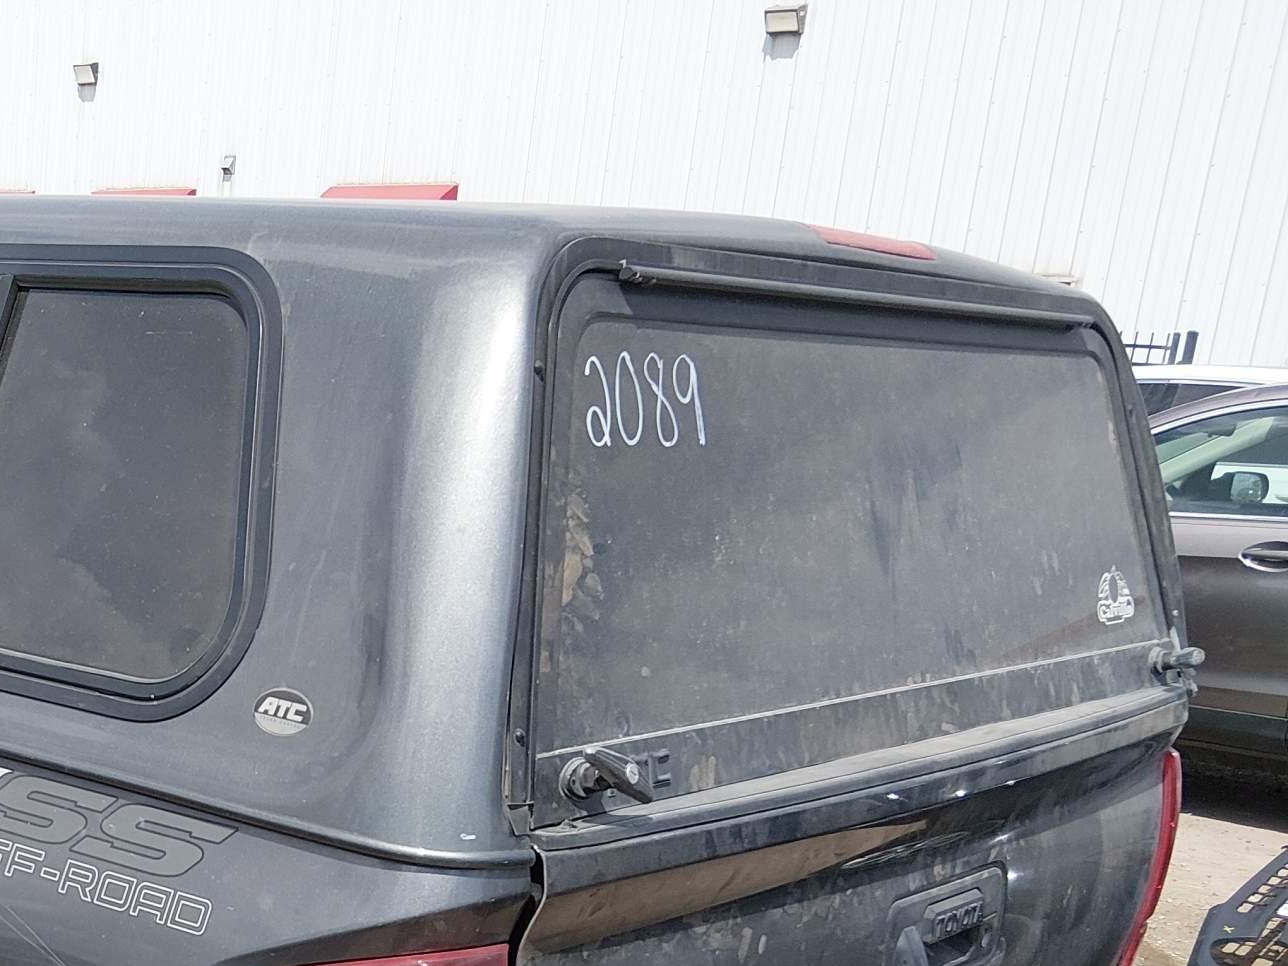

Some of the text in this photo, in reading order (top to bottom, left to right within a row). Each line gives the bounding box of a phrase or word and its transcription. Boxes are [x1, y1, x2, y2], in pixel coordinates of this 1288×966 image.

[584, 351, 705, 447] 2089
[257, 696, 307, 722] ATC
[936, 901, 984, 939] TOYOTA
